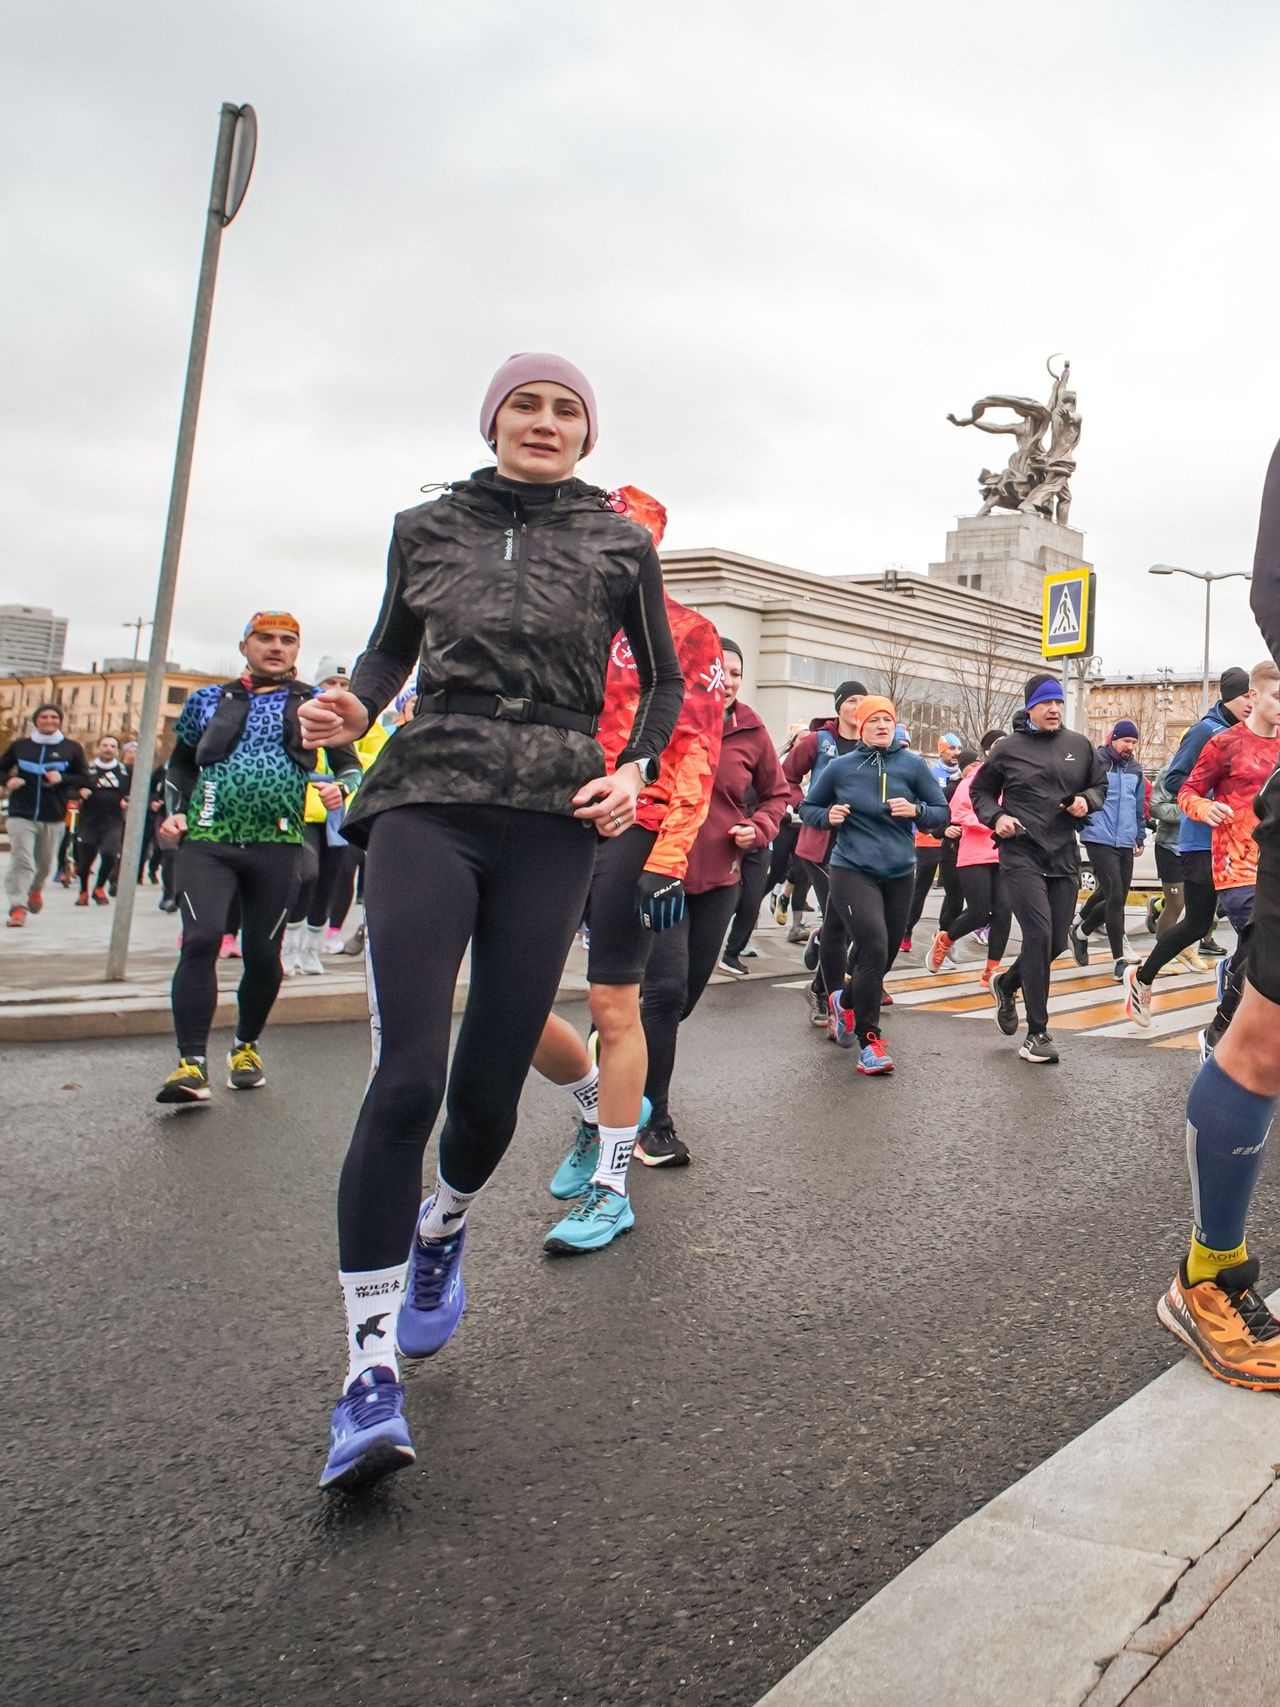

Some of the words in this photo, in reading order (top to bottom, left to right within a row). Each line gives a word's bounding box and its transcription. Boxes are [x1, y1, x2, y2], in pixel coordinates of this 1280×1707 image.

[504, 537, 514, 561] Reebok
[355, 1282, 390, 1292] WILD
[355, 1288, 390, 1298] TRAIL
